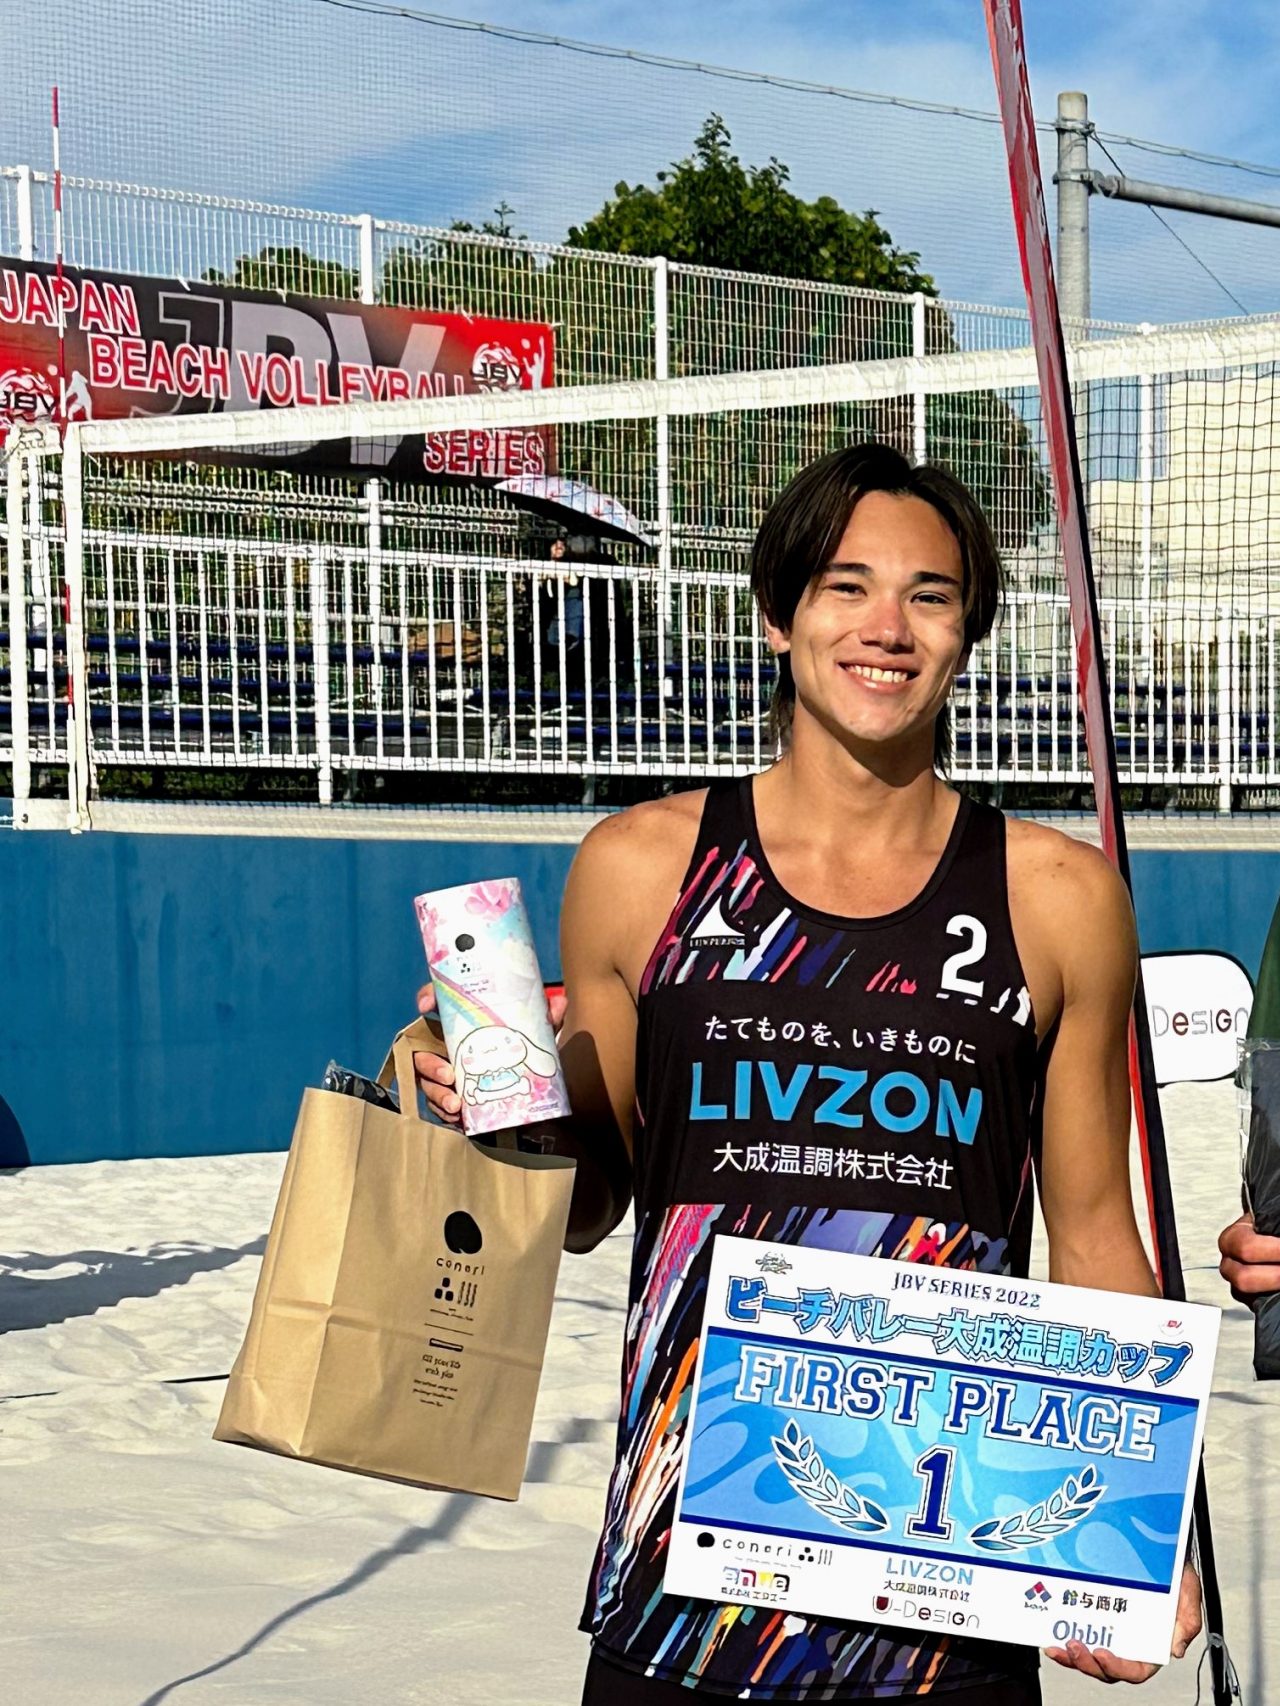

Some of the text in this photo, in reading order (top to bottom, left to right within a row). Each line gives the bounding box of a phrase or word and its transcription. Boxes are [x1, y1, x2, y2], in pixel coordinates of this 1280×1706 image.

[0, 268, 141, 336] JAPAN
[88, 332, 231, 400] BEACH
[423, 429, 546, 476] SERIES
[940, 913, 988, 998] 2
[704, 1015, 977, 1065] たてものを、いきものに
[689, 1060, 984, 1145] LIVZON
[713, 1141, 954, 1190] 大成温調株式会社
[891, 1272, 1042, 1309] JBV SERIES 2022
[726, 1275, 1193, 1388] ビーチバレー大成温調カップ
[734, 1344, 1162, 1463] FIRST PLACE
[904, 1444, 959, 1544] 1
[722, 1538, 793, 1556] coneri
[886, 1557, 974, 1585] LIVZON
